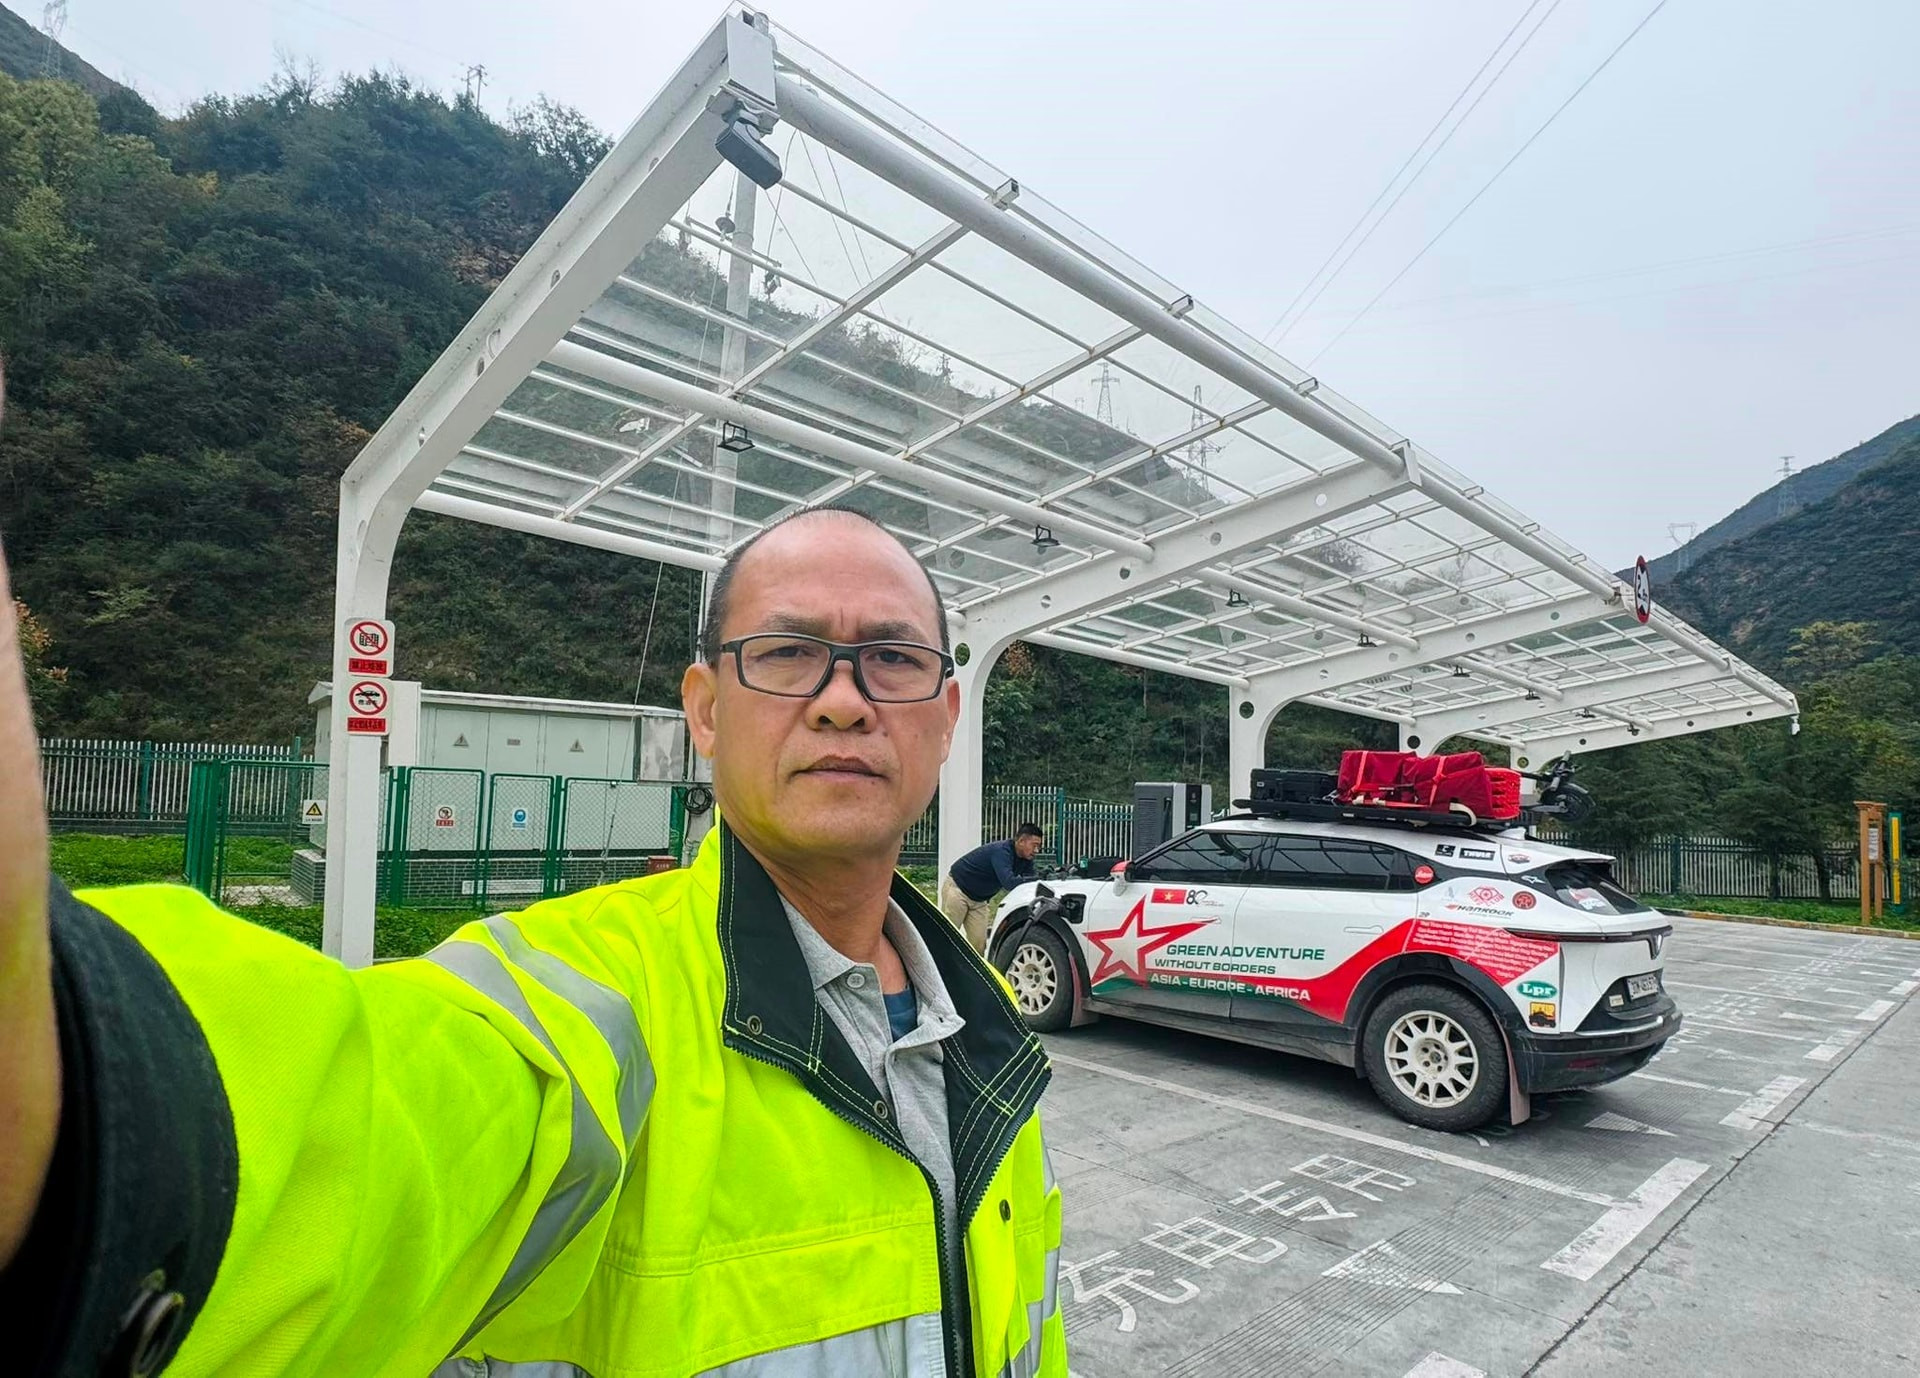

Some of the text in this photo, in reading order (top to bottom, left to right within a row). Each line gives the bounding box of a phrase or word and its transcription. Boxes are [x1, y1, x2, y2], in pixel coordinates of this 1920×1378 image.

[1166, 944, 1326, 960] GREEN ADVENTURE
[1154, 958, 1276, 975] WITHOUT BORDERS
[1150, 973, 1182, 985] ASIA
[1189, 977, 1246, 993] EUROPE
[1254, 985, 1311, 1001] AFRICA
